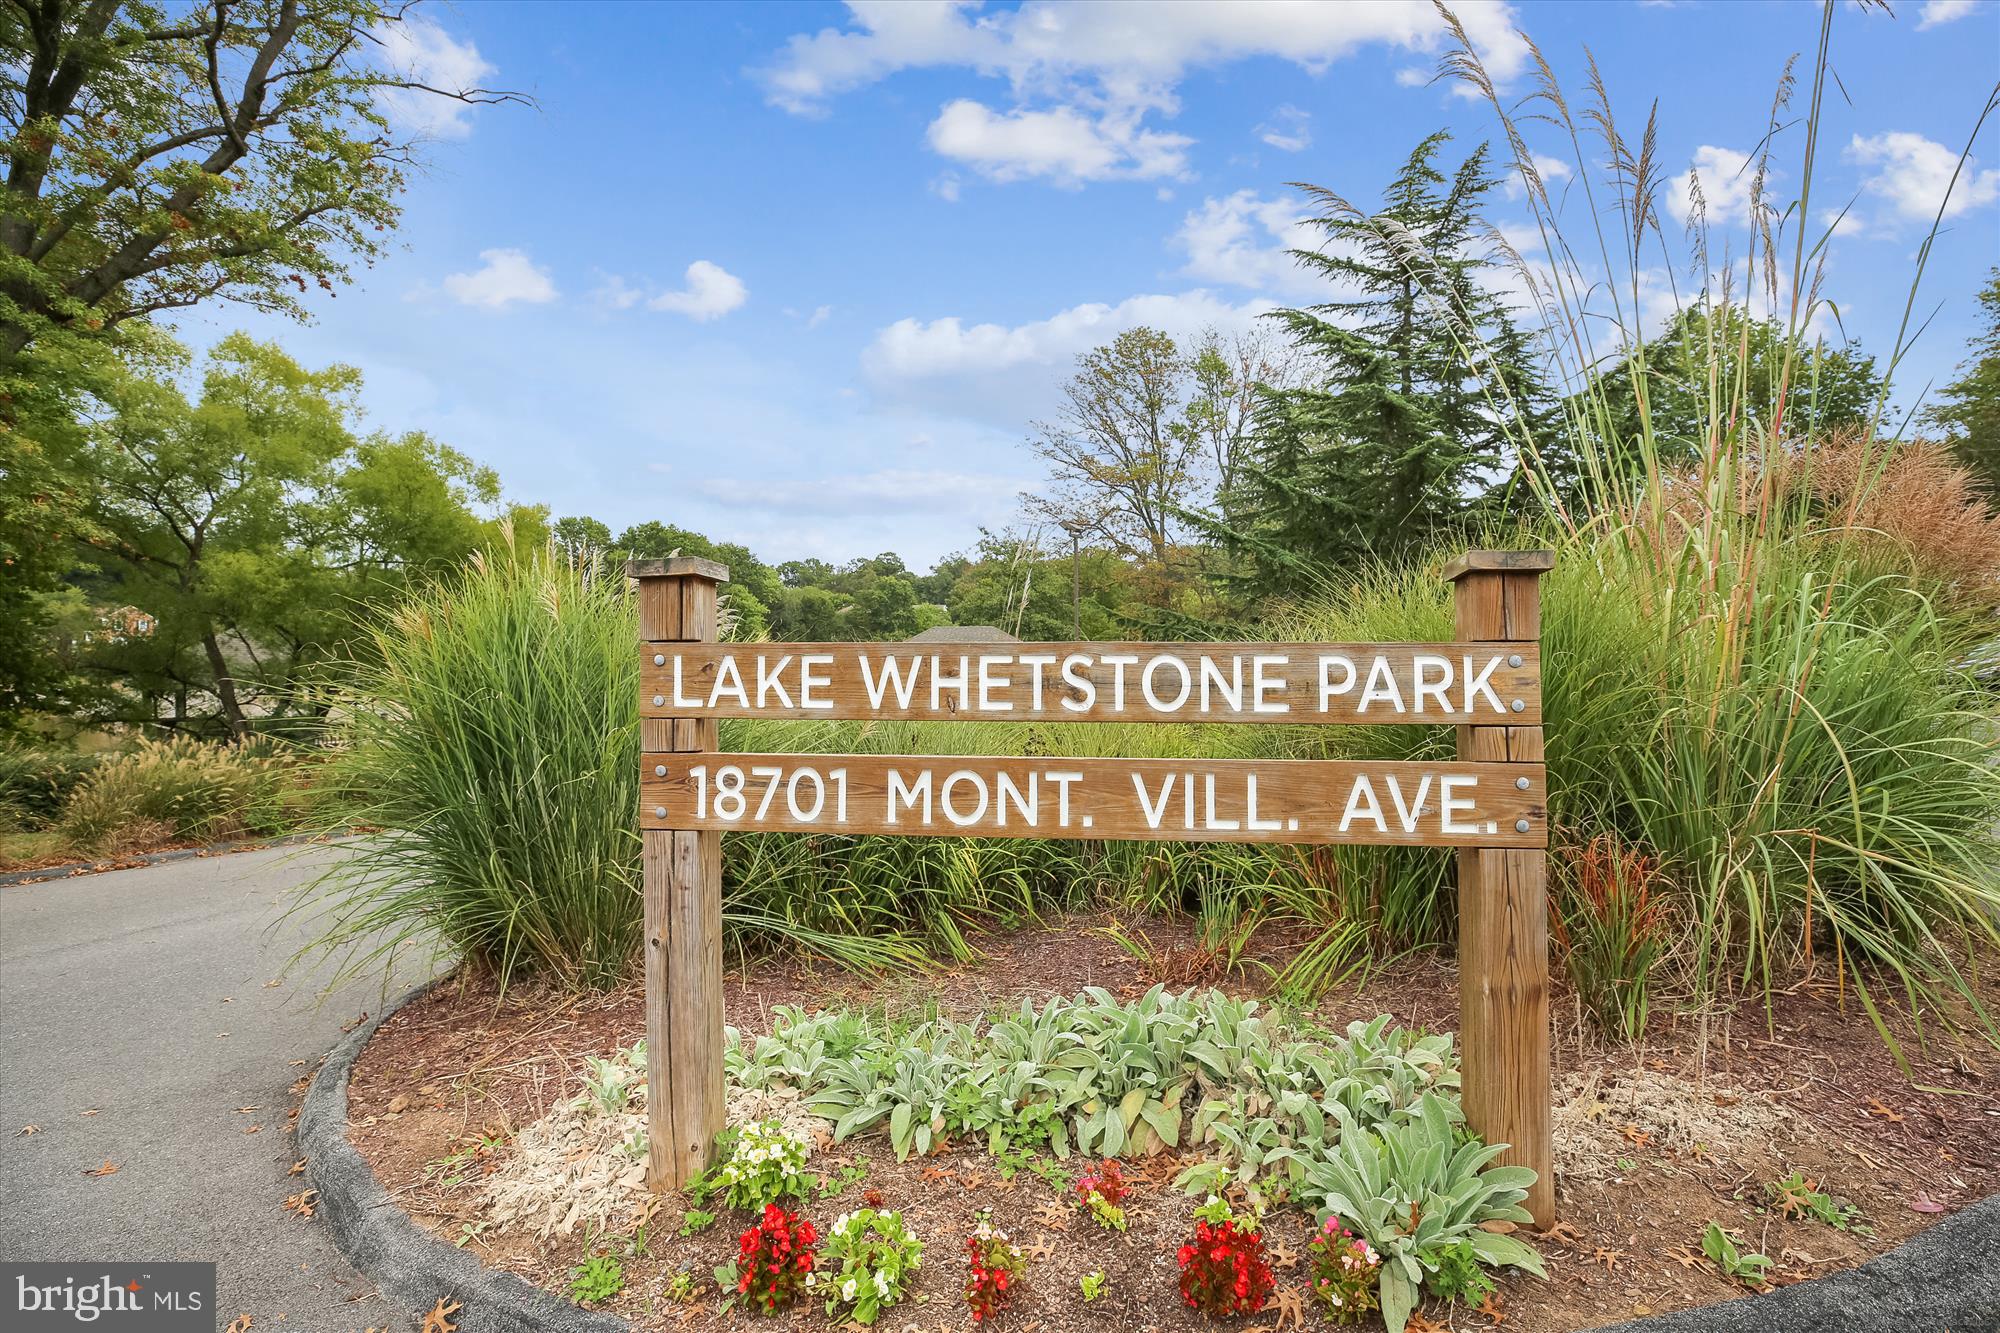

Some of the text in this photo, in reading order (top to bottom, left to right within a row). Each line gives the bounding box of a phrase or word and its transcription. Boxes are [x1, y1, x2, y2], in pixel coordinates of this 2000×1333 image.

[672, 653, 1508, 715] LAKE WHETSTONE PARK
[688, 764, 1498, 835] 18701 MONT. VILL. AVE.
